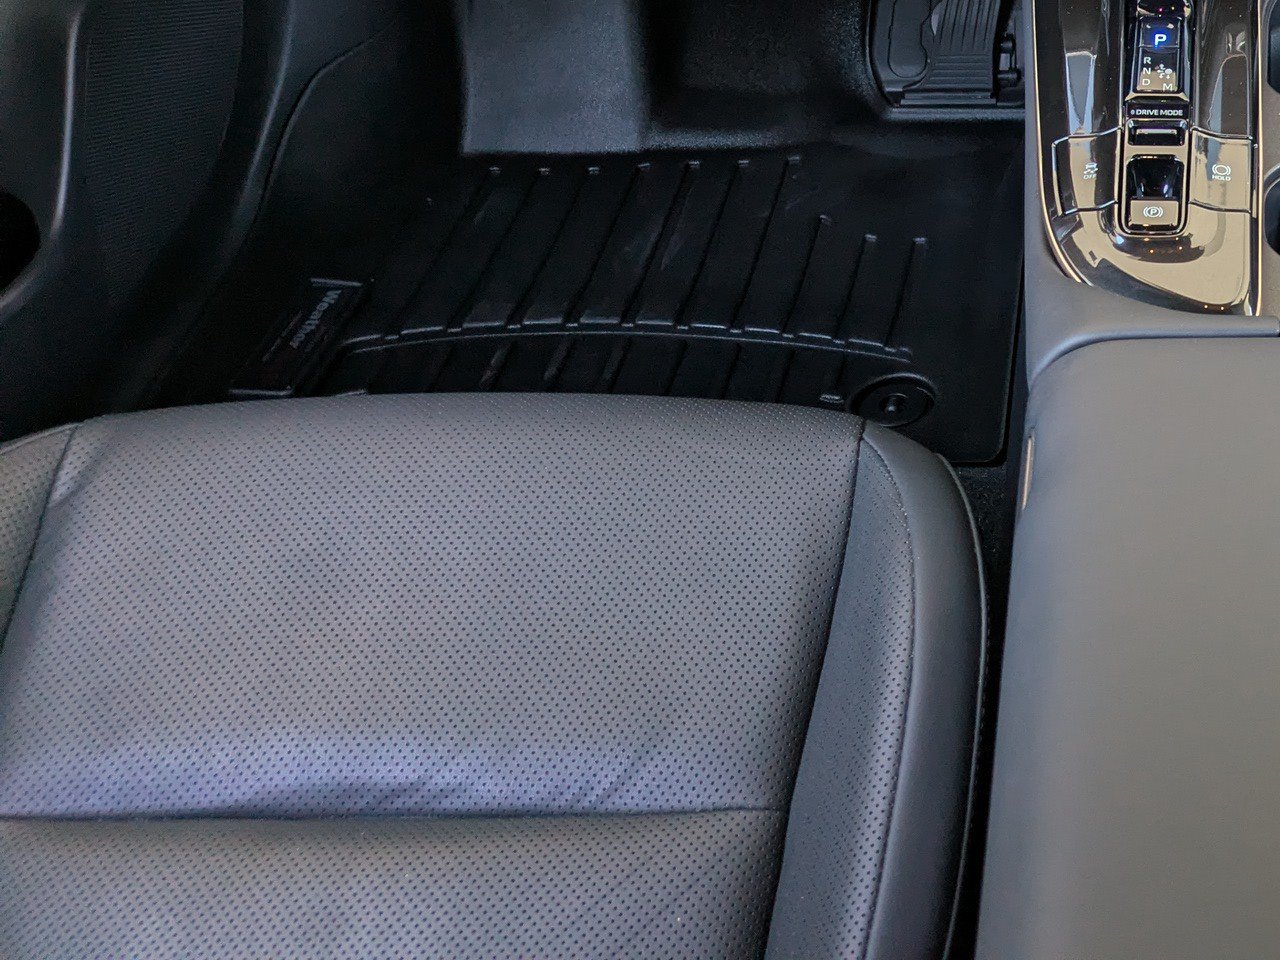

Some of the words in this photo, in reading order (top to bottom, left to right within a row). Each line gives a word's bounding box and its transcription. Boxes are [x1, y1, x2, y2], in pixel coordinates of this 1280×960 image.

[1154, 33, 1167, 47] P
[1143, 56, 1152, 65] R
[1142, 67, 1152, 75] N
[1141, 78, 1151, 86] D
[1162, 83, 1173, 92] M
